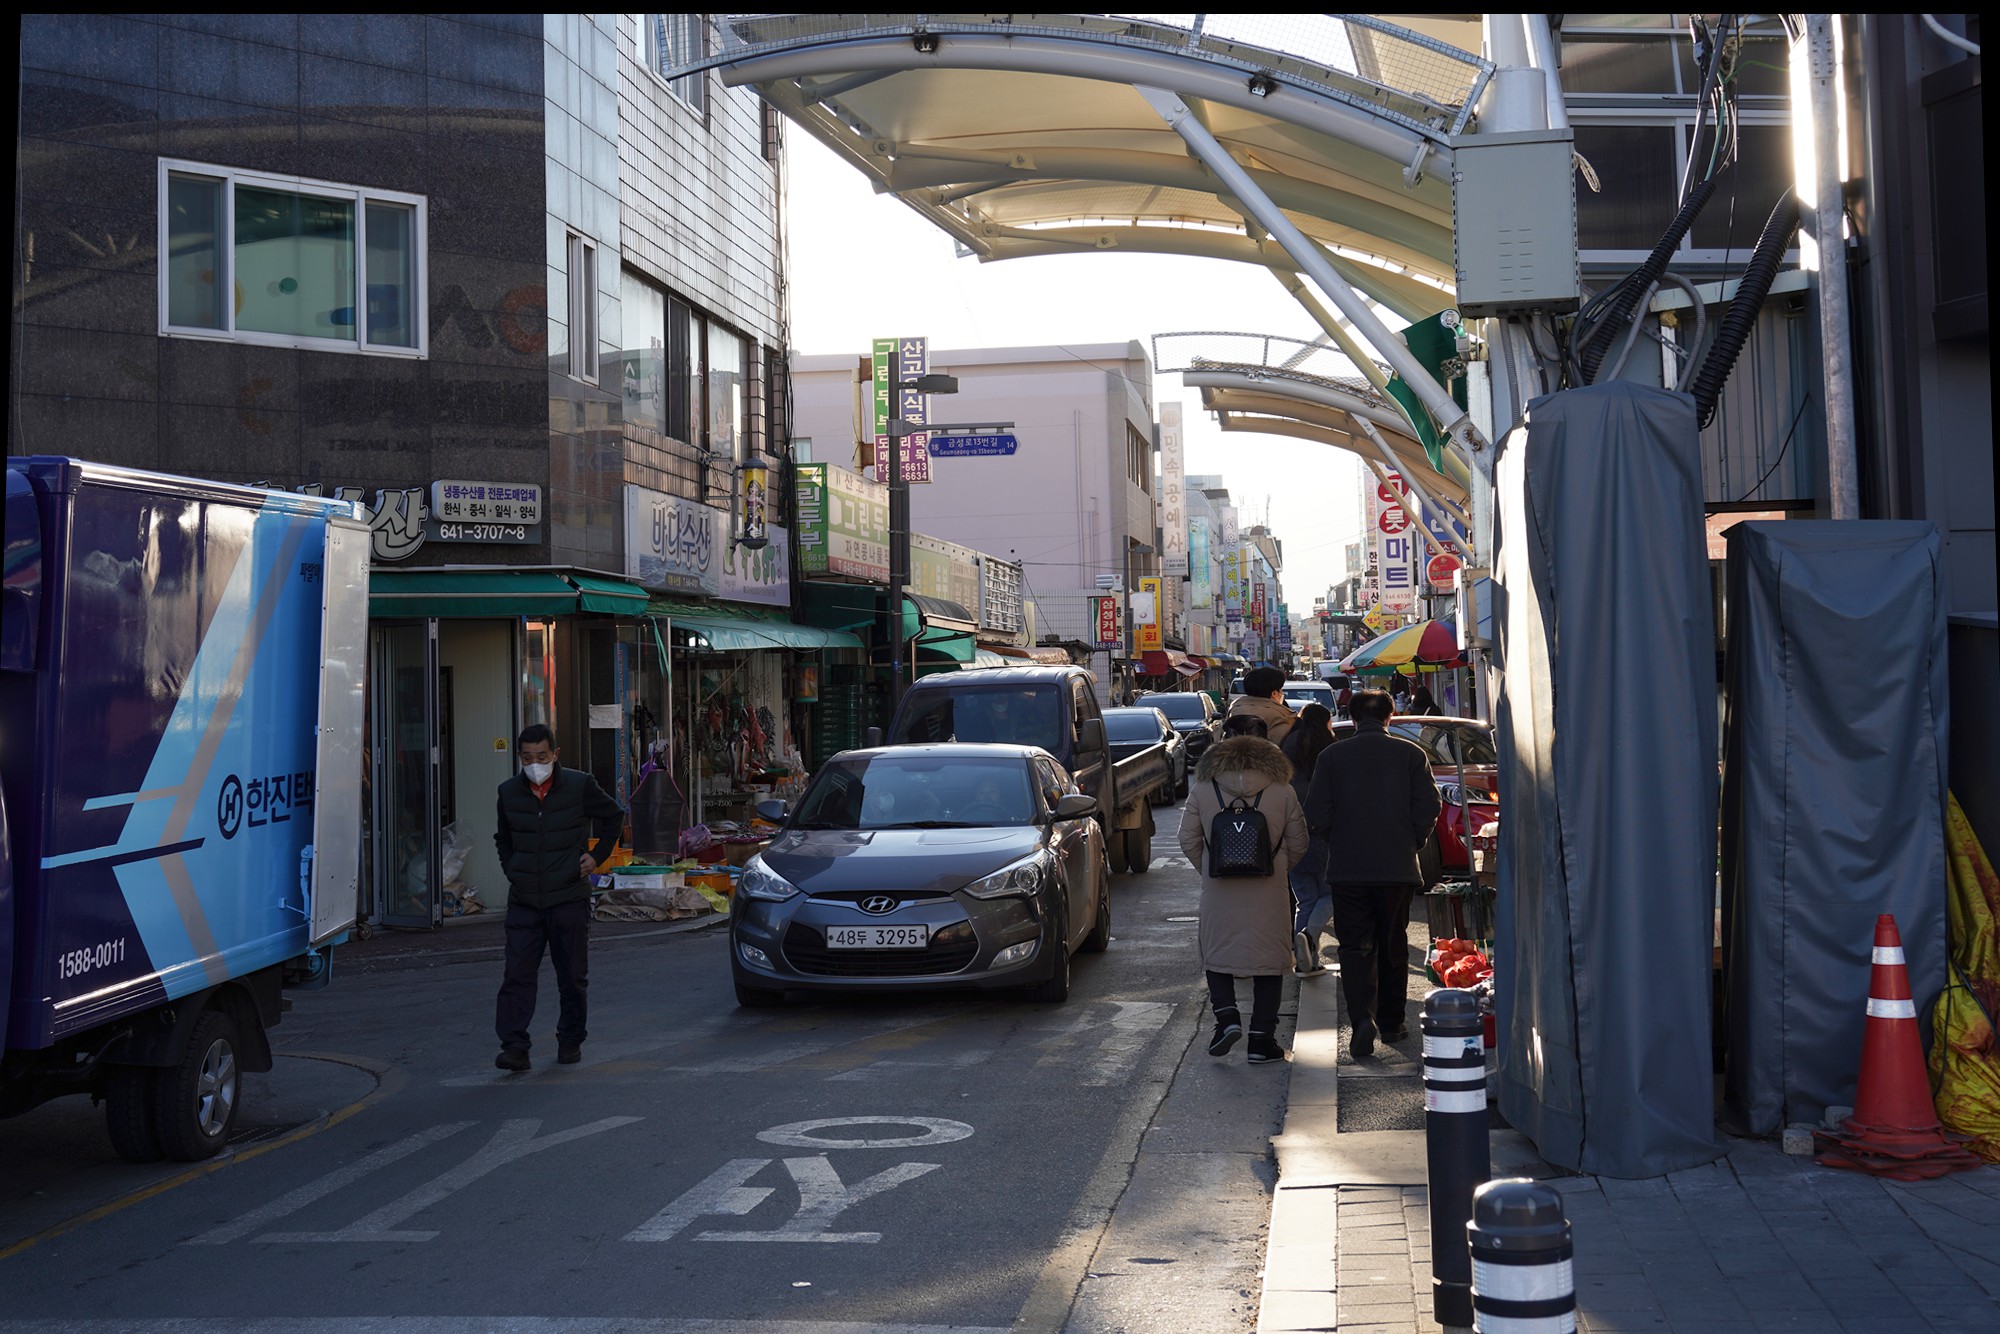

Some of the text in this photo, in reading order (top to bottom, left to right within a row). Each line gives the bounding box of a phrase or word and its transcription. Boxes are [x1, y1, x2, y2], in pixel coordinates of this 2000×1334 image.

[947, 437, 998, 448] 금성로13번길
[1006, 441, 1014, 449] 14
[443, 485, 537, 502] 냉동수산물 전문도매업체
[1164, 432, 1184, 553] 민속공예사
[440, 524, 525, 540] 641-3707~8
[651, 502, 712, 573] 바다수산
[844, 499, 889, 541] 그린두
[1224, 518, 1240, 601] 서울공예사
[1102, 600, 1114, 640] 삼성커텐
[1233, 821, 1245, 833] V
[836, 929, 918, 945] 48두 3295
[58, 937, 125, 979] 1588-0011
